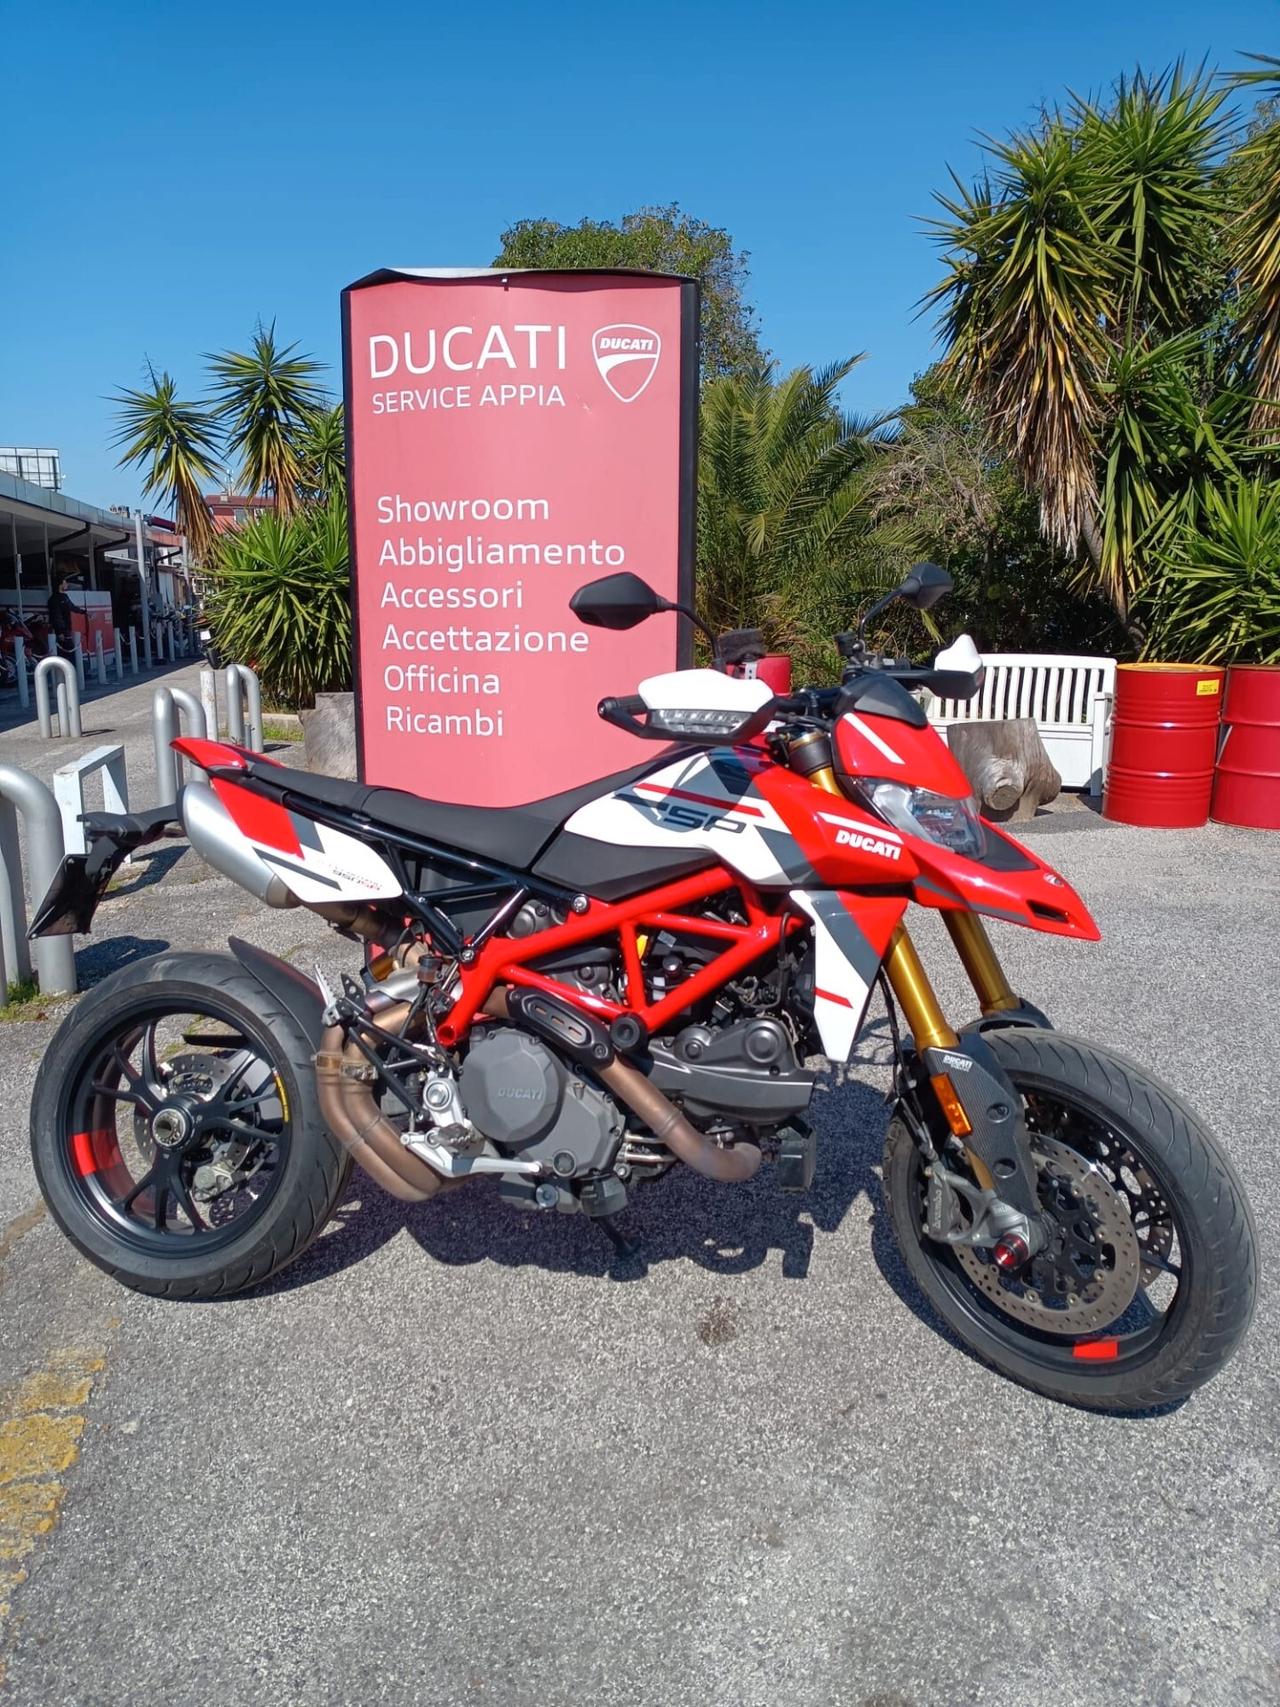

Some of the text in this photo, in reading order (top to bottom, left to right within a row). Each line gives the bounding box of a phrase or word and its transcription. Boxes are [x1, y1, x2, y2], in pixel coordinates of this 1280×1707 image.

[369, 324, 566, 379] DUCATI
[599, 337, 654, 351] DUCATI
[372, 385, 566, 414] SERVICE APPIA
[377, 495, 550, 524] Showroom
[379, 536, 625, 573] Abbigliamento
[380, 581, 523, 609] Accessori
[382, 624, 590, 652] Accettazione
[384, 664, 500, 694] Officina
[386, 706, 503, 737] Ricambi
[836, 829, 902, 860] DUCATI
